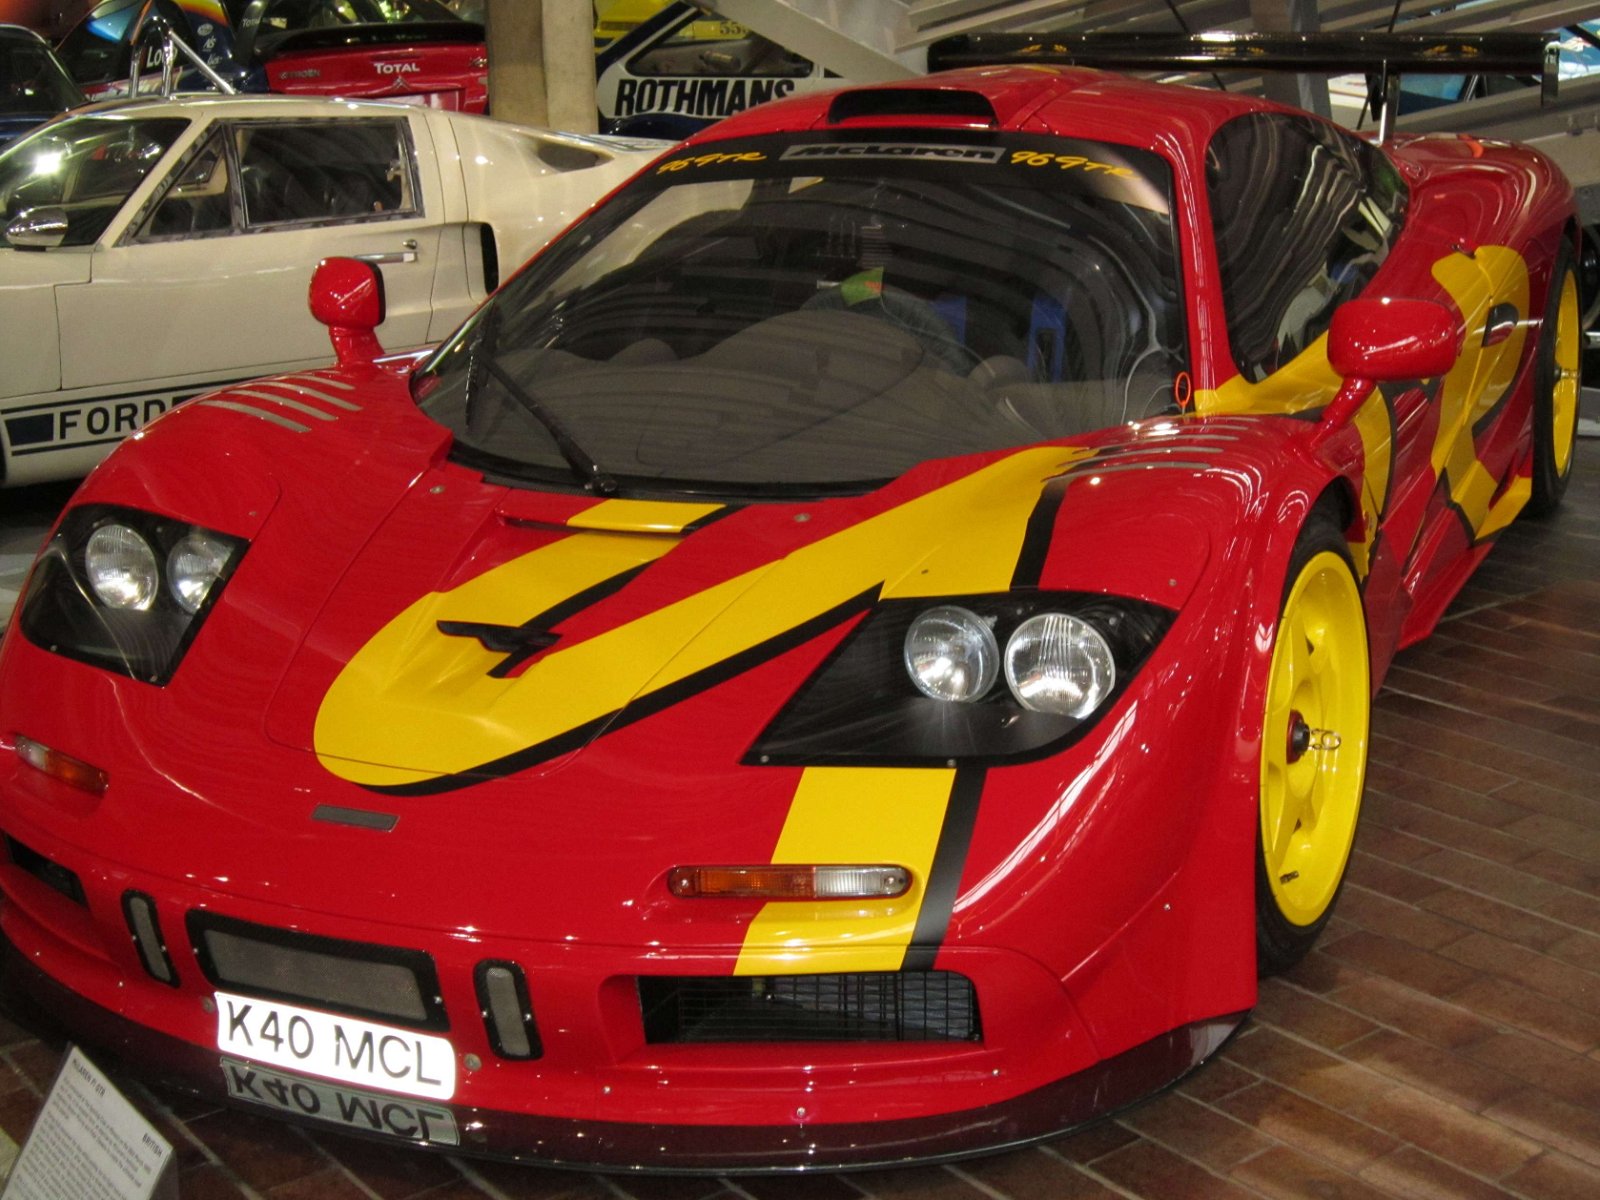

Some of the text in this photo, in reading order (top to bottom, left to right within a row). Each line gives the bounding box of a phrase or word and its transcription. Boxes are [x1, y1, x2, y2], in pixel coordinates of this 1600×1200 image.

[374, 62, 420, 74] TOTAL
[614, 79, 796, 117] ROTHMANS
[788, 145, 997, 160] McLaren
[60, 399, 166, 440] FORD
[227, 1001, 442, 1086] K40 MCL
[142, 1132, 163, 1158] BRITISH
